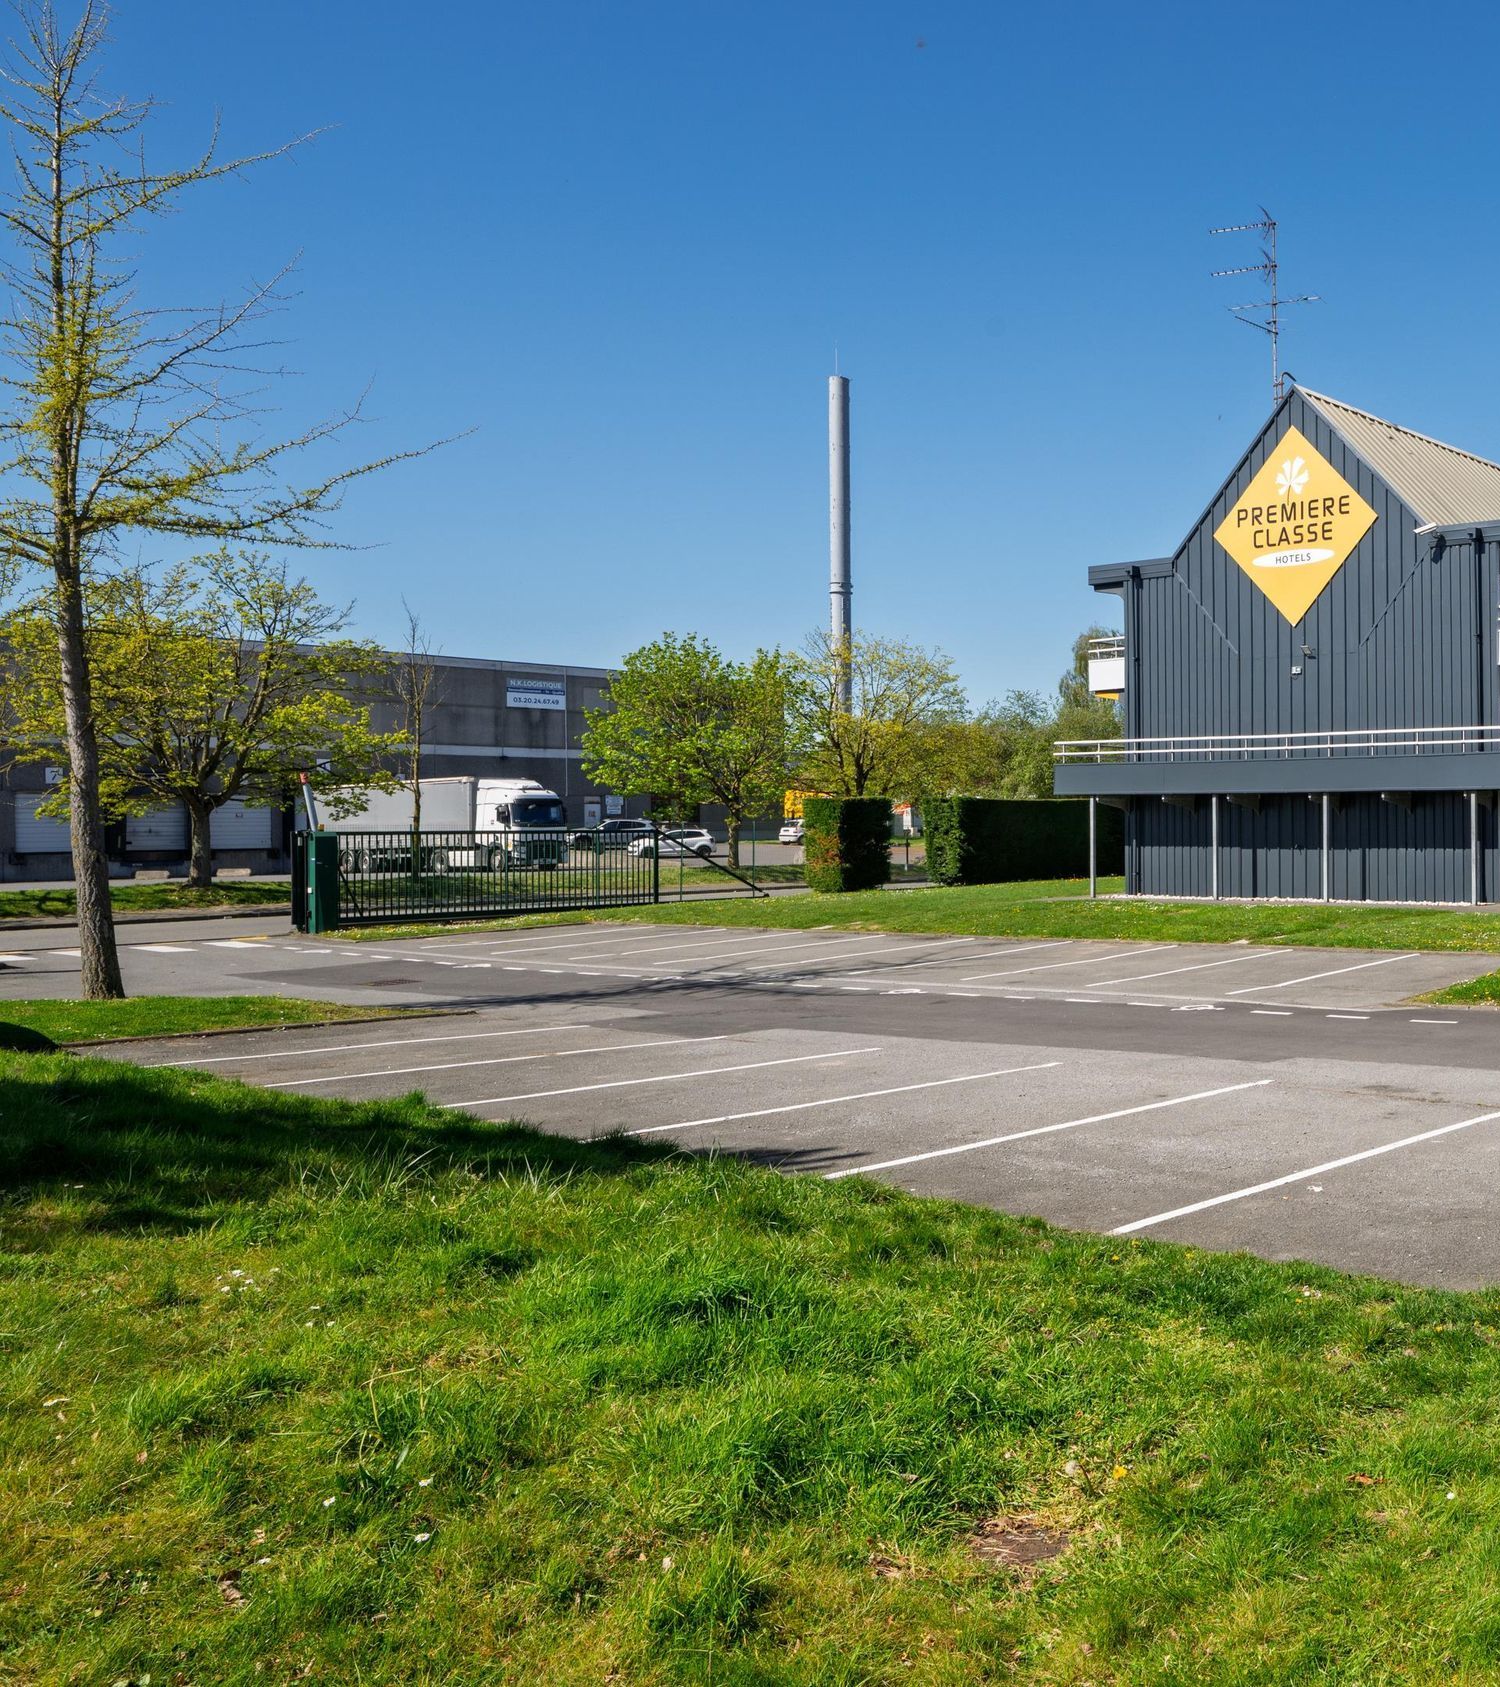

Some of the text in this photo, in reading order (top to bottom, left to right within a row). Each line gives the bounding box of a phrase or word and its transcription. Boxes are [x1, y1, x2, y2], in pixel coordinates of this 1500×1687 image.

[1237, 495, 1350, 528] PREMIERE
[1253, 521, 1333, 549] CLASSE
[1275, 552, 1312, 565] HOTELS
